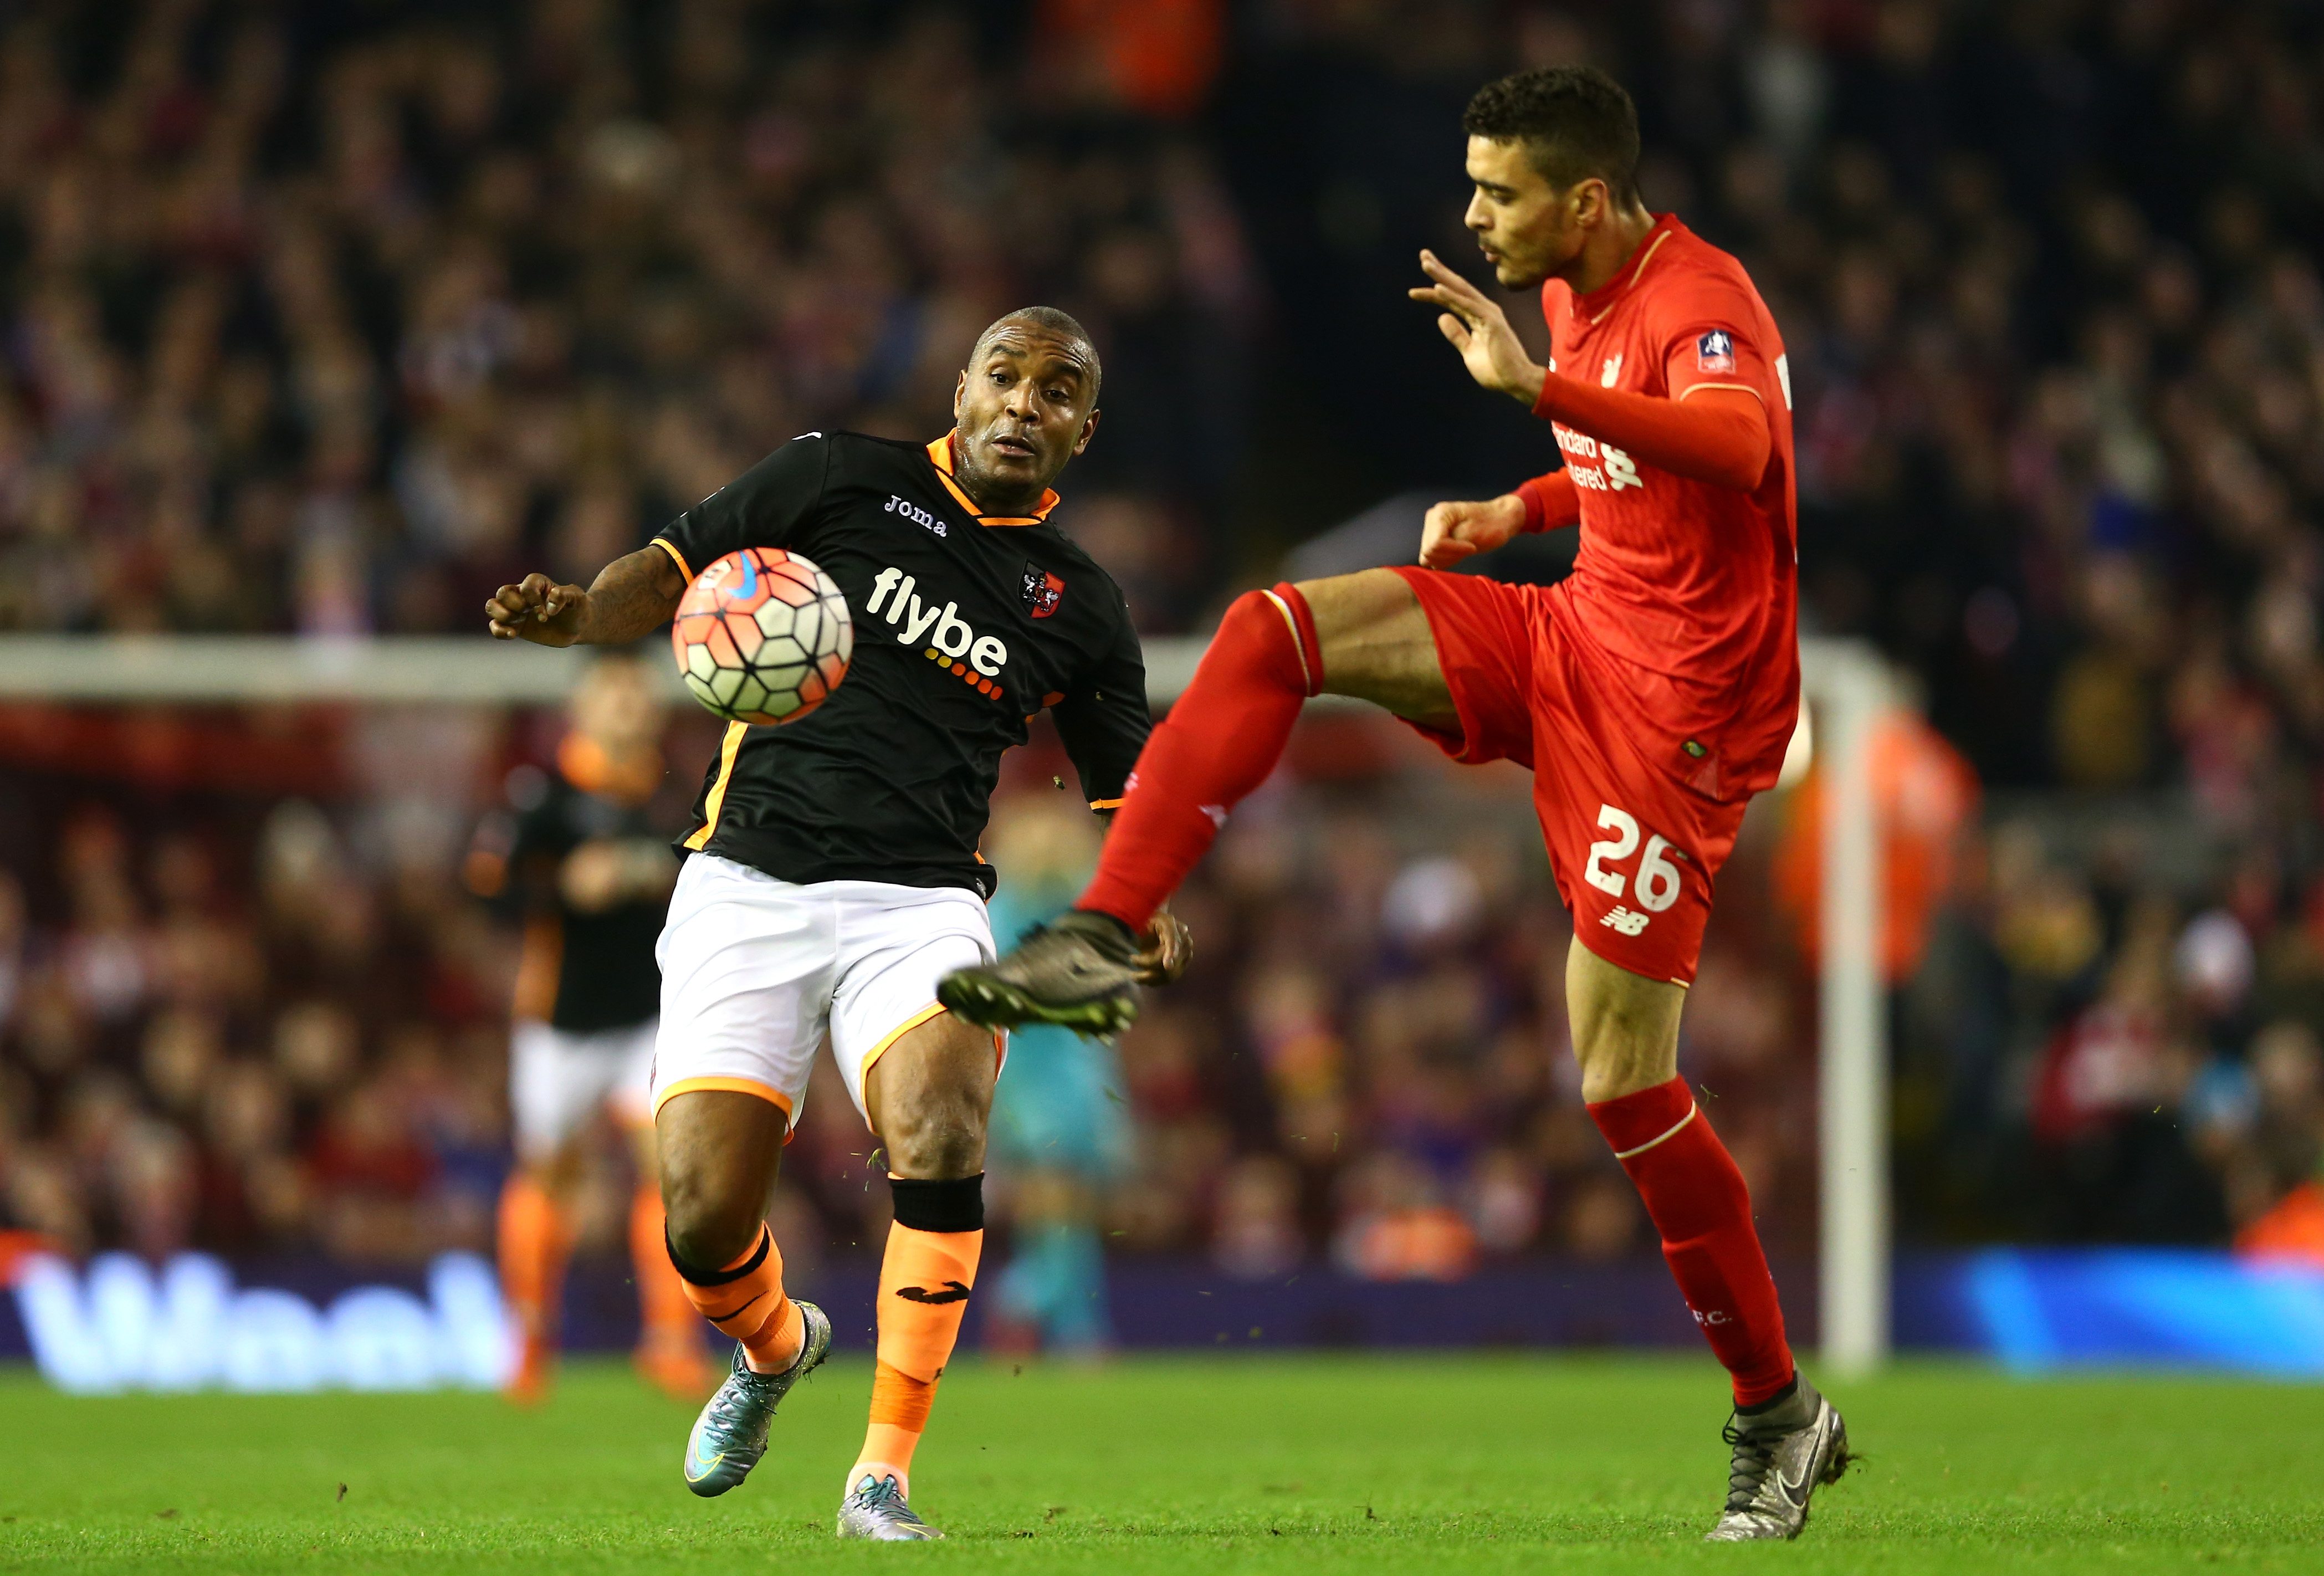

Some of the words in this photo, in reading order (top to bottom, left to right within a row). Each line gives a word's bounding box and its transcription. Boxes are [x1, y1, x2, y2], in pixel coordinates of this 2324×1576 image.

[884, 495, 947, 537] Joma
[866, 567, 1007, 677] flybe
[1584, 803, 1688, 912] 26
